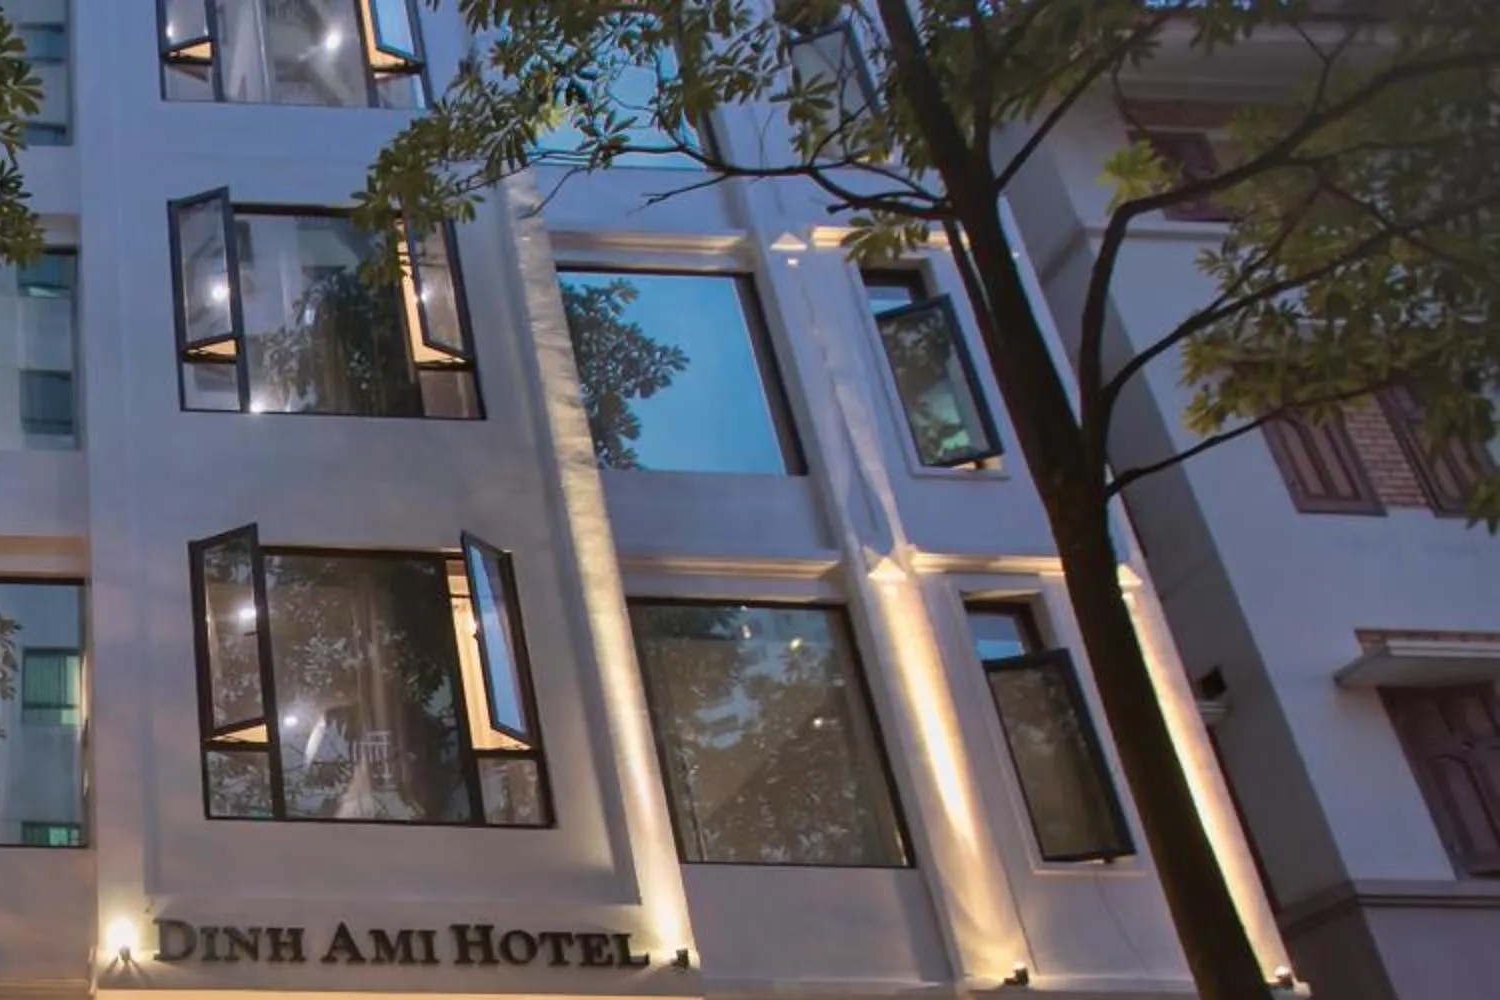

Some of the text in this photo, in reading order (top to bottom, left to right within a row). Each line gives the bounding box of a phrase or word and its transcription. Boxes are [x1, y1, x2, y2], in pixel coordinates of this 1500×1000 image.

[152, 917, 650, 967] DINH AMI HOTEL
